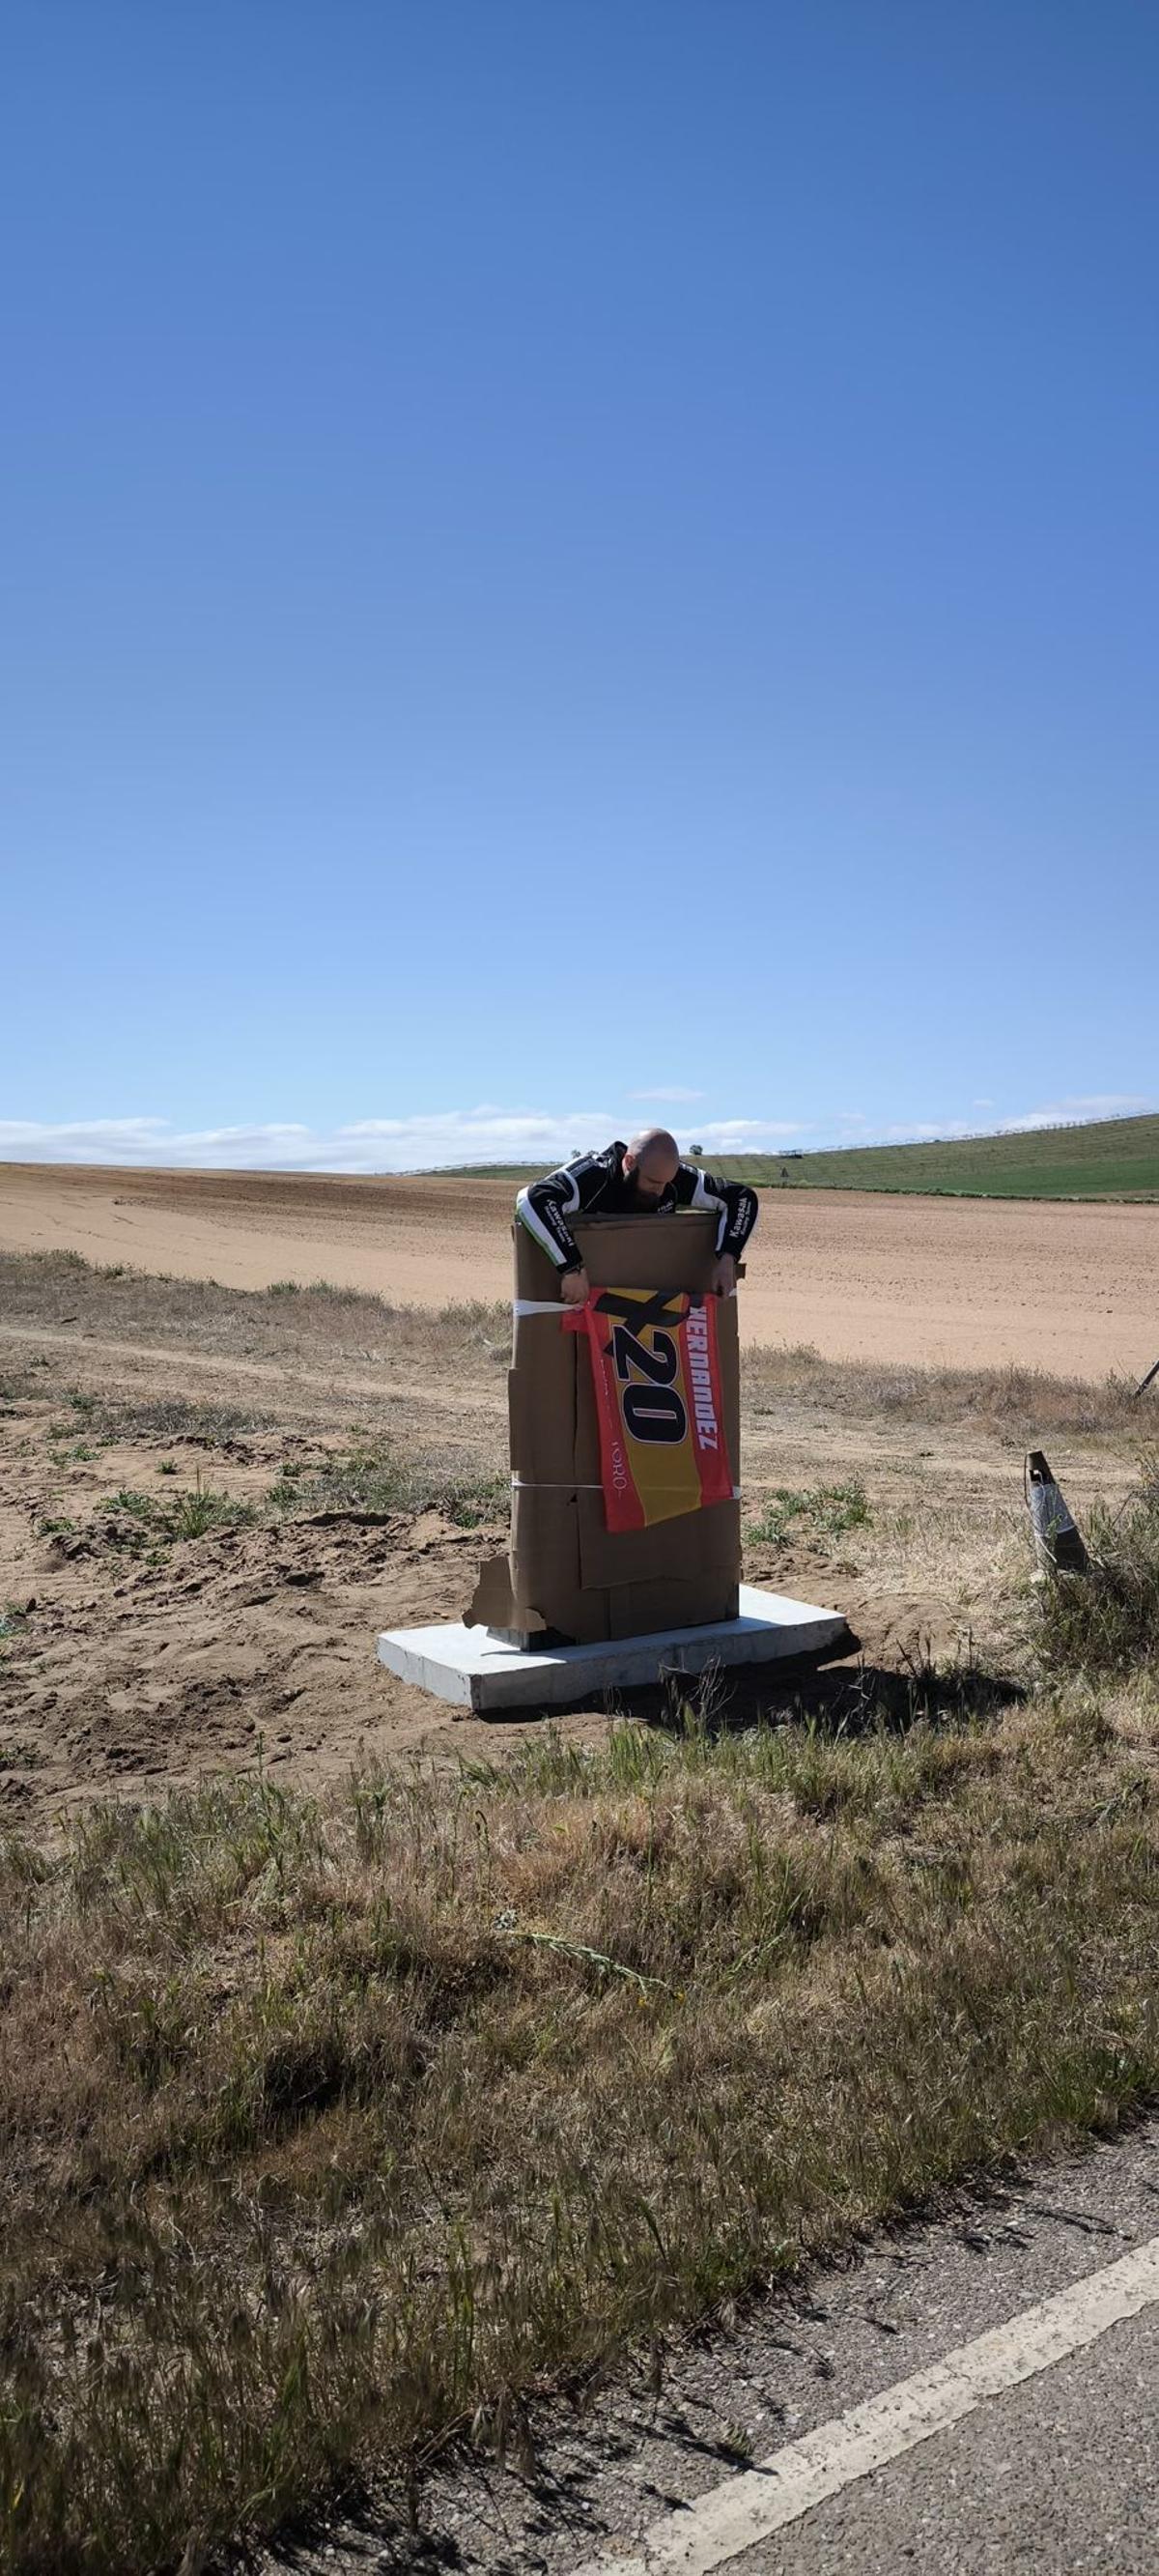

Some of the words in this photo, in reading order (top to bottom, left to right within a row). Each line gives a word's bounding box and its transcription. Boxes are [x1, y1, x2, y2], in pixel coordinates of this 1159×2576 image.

[729, 1197, 748, 1238] Kawasak
[612, 1324, 688, 1445] 20
[687, 1305, 719, 1450] HERNANDEZ
